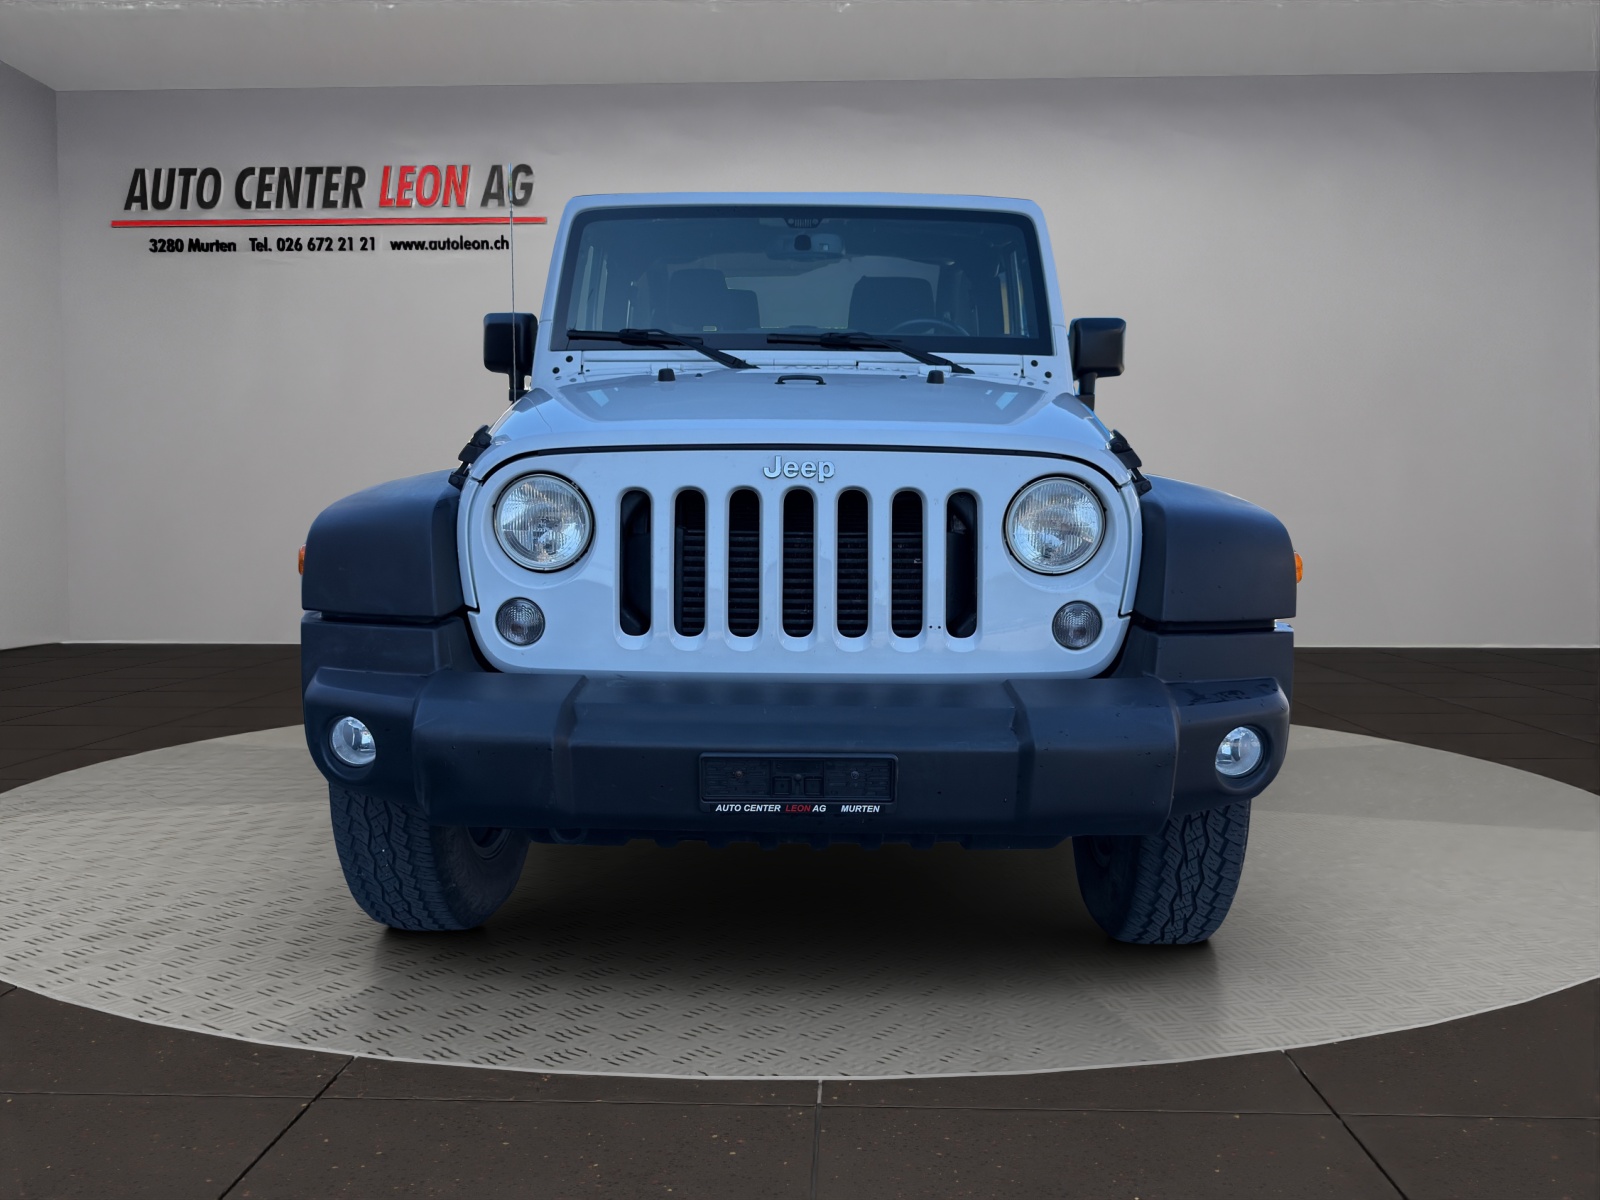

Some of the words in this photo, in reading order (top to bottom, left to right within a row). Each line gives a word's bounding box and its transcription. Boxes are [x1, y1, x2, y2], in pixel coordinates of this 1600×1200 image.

[124, 166, 221, 210] AUTO
[234, 166, 367, 209] CENTER
[379, 165, 471, 207] LEON
[481, 163, 535, 207] AG
[149, 238, 184, 253] 3280
[187, 238, 237, 253] Murten
[249, 238, 273, 252] Tel.
[276, 237, 303, 252] 026
[307, 237, 334, 252] 672
[338, 237, 355, 251] 21
[359, 237, 377, 251] 21
[390, 235, 510, 252] www.autoleon.ch
[763, 455, 835, 483] Jeep
[715, 804, 742, 812] AUTO
[743, 804, 781, 812] CENTER
[785, 804, 811, 812] LEON
[812, 804, 827, 813] AG
[841, 805, 880, 813] MURTEN
